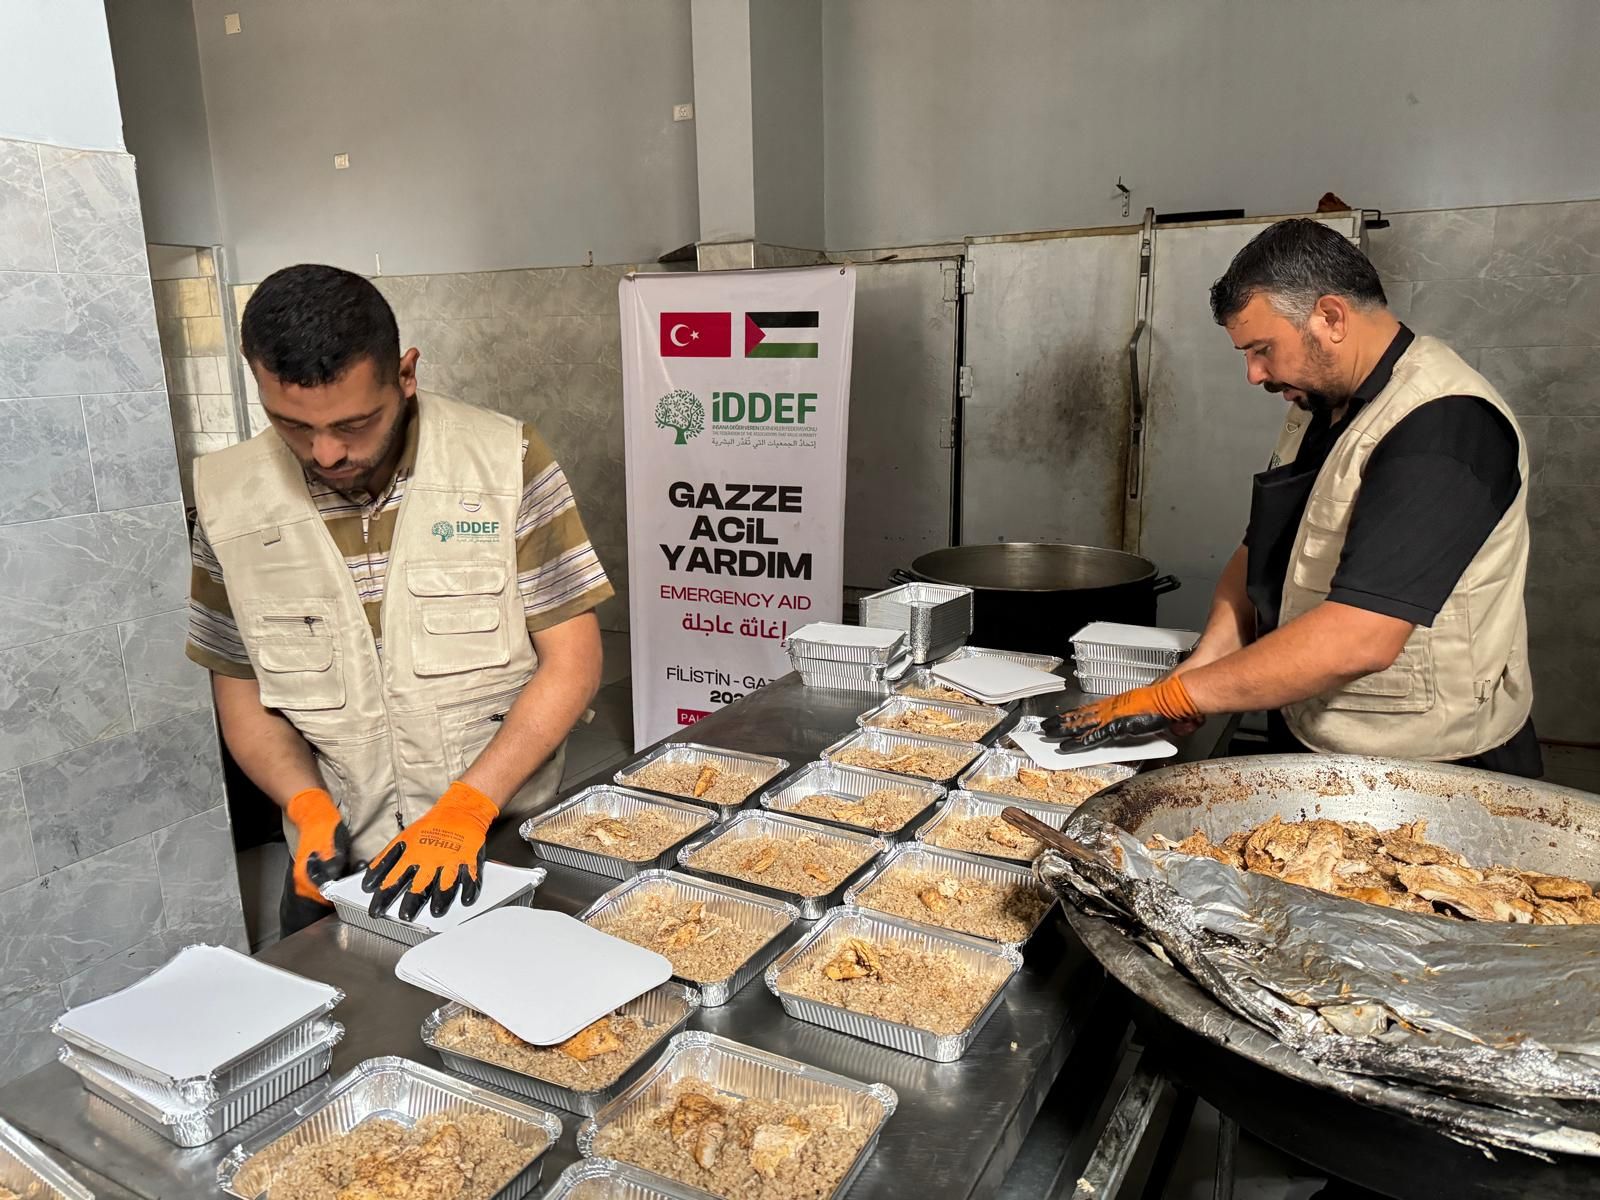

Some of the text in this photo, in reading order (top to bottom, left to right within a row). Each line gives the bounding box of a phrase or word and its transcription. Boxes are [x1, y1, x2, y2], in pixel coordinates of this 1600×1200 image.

[668, 481, 803, 513] GAZZE
[659, 543, 812, 581] YARDIM
[660, 585, 812, 610] EMERGENCY AID
[682, 613, 788, 648] إغاثة عاجلة
[742, 675, 776, 690] GA
[419, 837, 462, 852] ETIHAD
